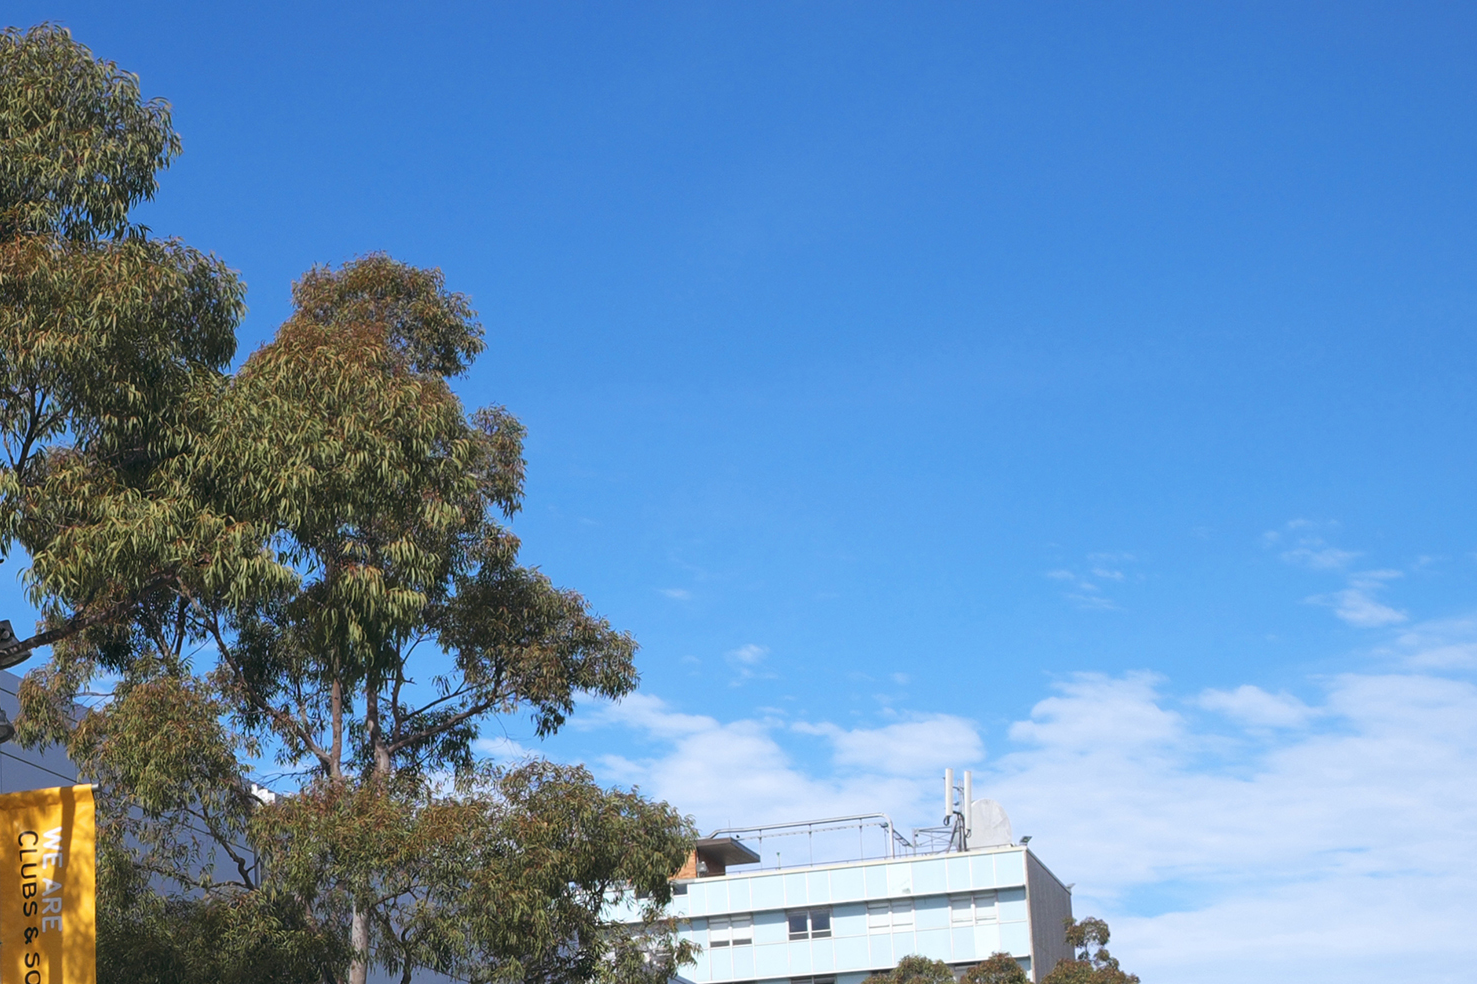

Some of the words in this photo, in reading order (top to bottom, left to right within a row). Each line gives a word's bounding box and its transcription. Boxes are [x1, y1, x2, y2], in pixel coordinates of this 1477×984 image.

[42, 826, 63, 869] WE
[18, 830, 39, 917] CLUBS
[42, 877, 63, 933] ARE
[24, 926, 39, 945] &
